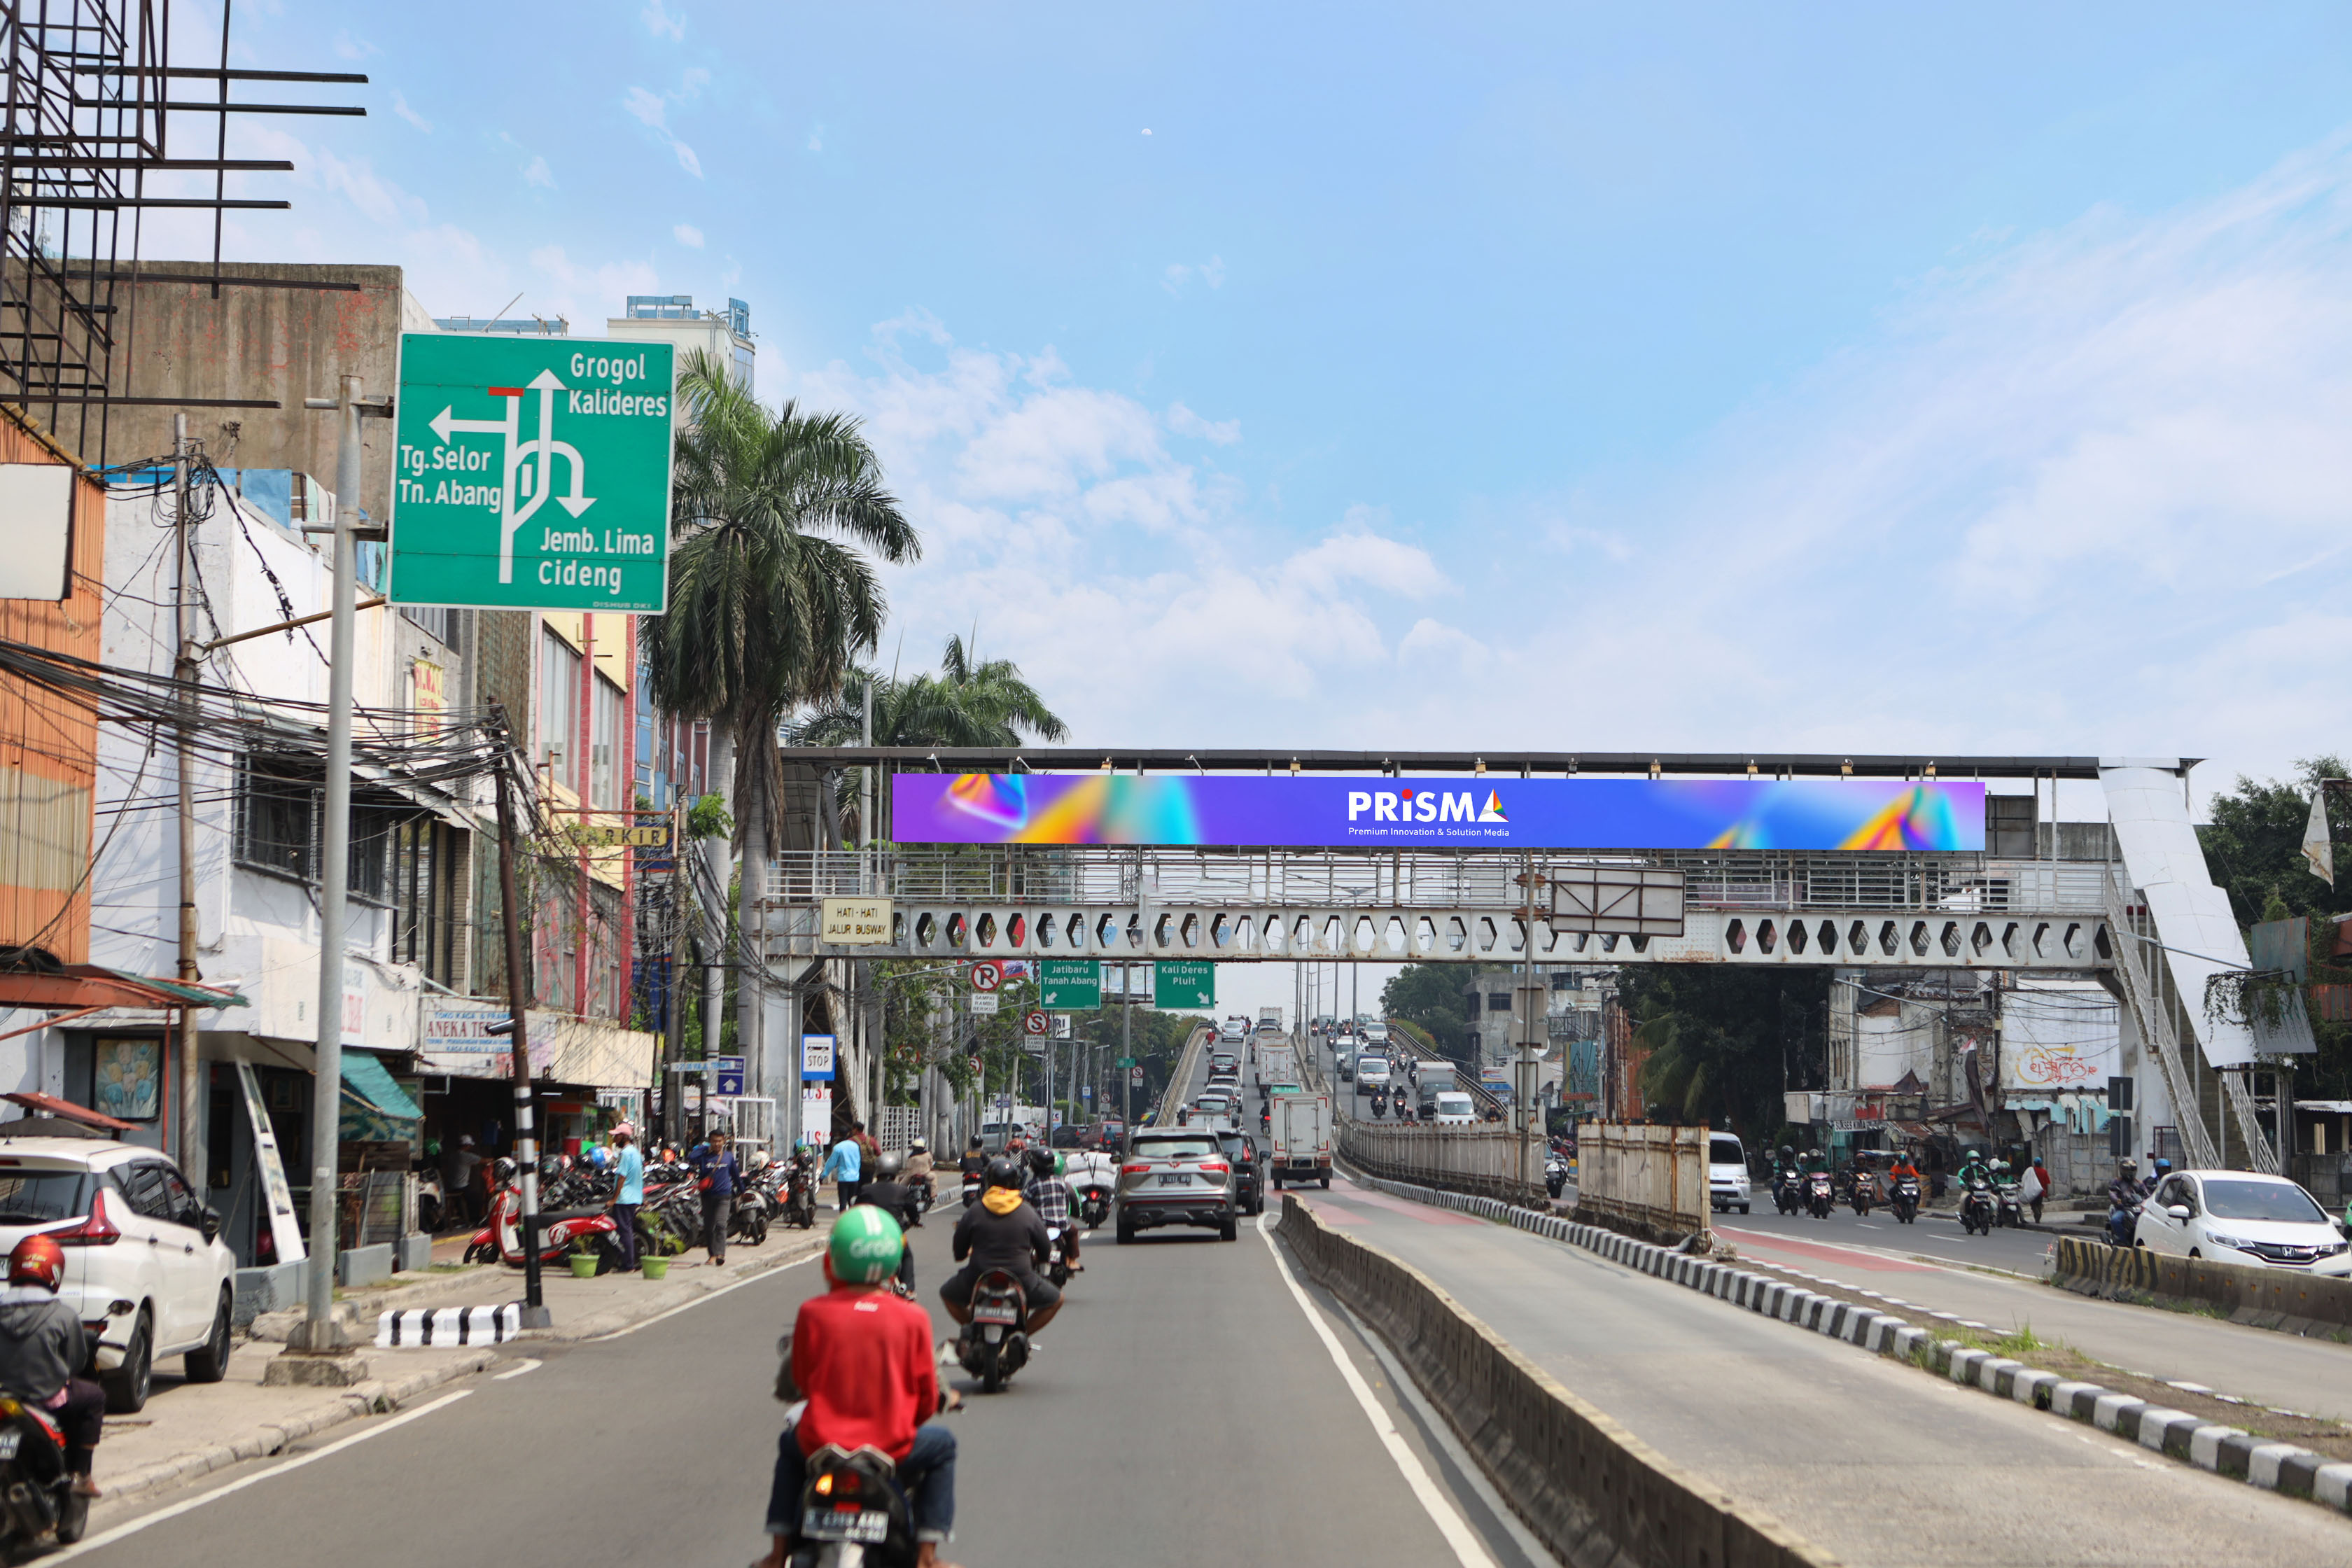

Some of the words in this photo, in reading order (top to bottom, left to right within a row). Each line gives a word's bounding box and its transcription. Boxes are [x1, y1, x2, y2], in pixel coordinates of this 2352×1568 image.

[570, 353, 645, 384] Grogol
[568, 389, 667, 417] Kalideres
[434, 479, 502, 514] Abang
[540, 527, 599, 553] Jemb.
[605, 528, 655, 554] Lima
[538, 560, 622, 595] Cideng
[1348, 827, 1388, 836] Premium
[1446, 828, 1481, 836] Solution
[836, 907, 854, 918] HATI
[860, 907, 878, 918] HATI
[827, 924, 851, 934] JALUR
[856, 924, 886, 934] BUSWAY
[1051, 965, 1088, 974] Jatibaru
[1070, 977, 1098, 986] Abang
[426, 1021, 467, 1037] ANEKA
[807, 1056, 829, 1067] STOP
